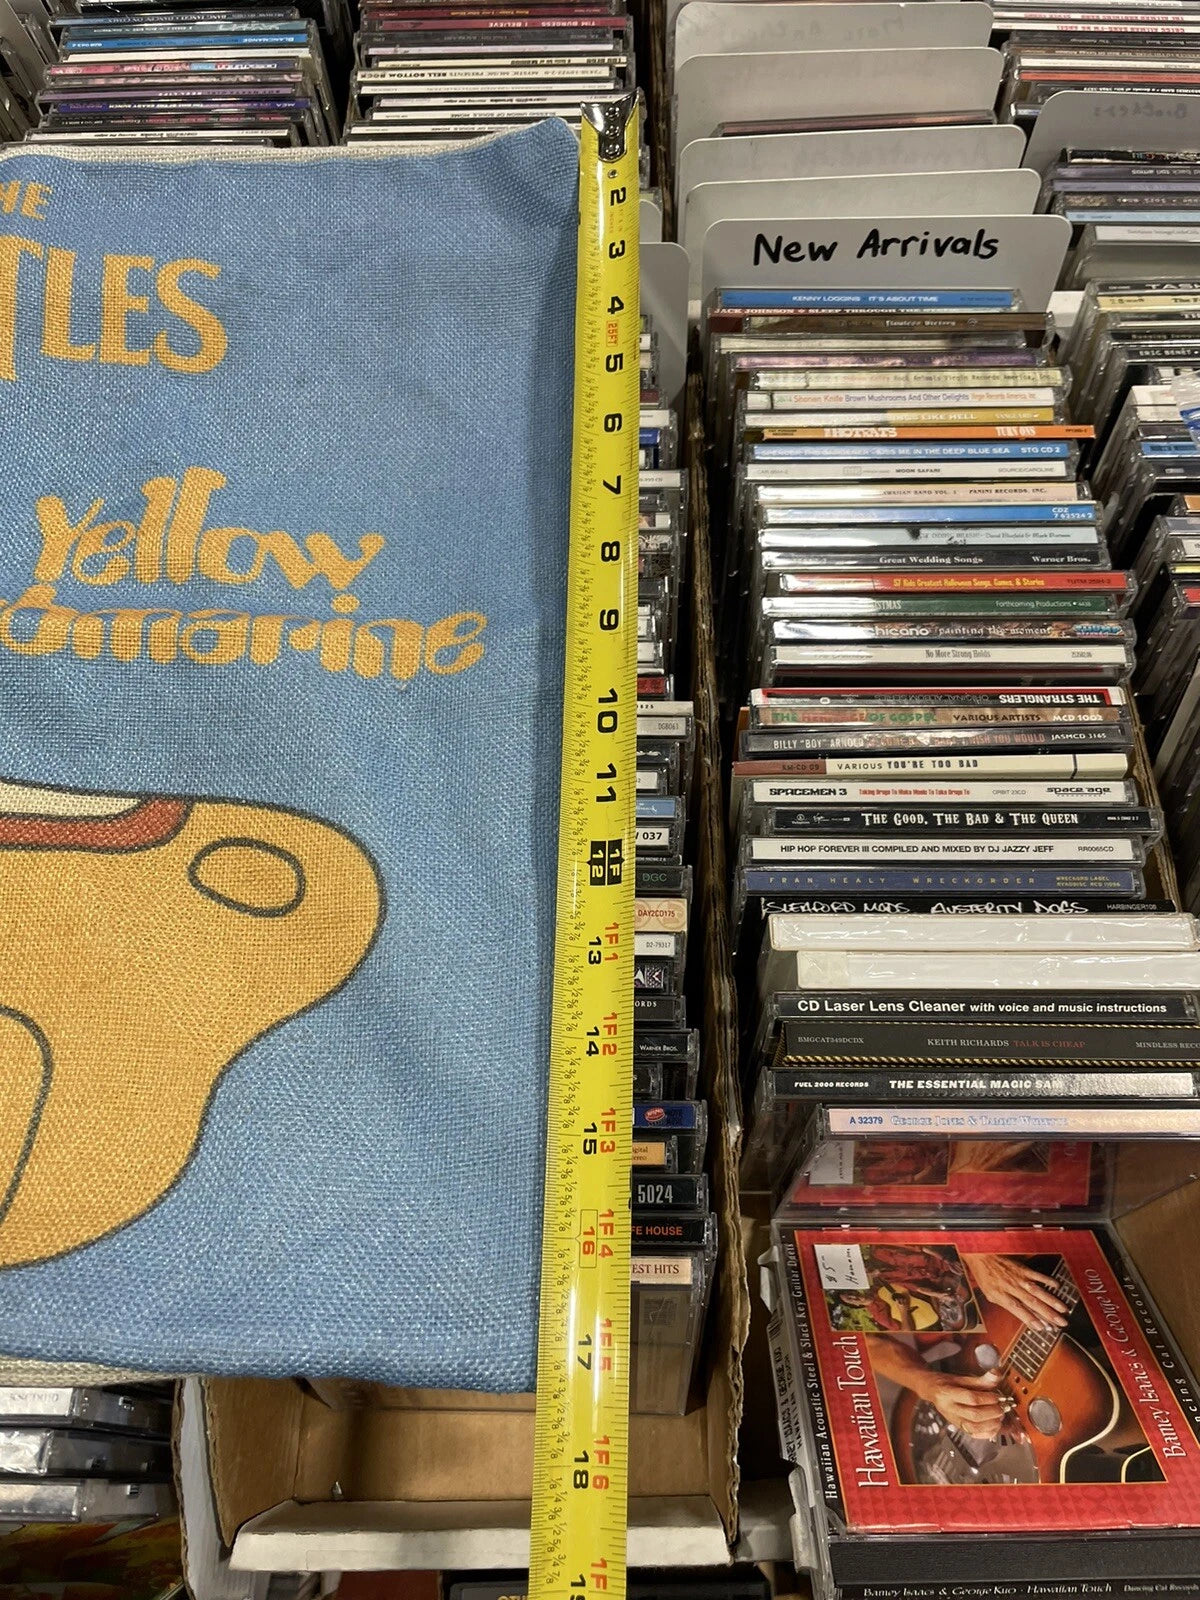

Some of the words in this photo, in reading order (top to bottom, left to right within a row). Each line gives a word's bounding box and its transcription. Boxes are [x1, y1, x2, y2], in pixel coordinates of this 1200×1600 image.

[610, 188, 626, 206] 2
[608, 240, 625, 259] 3
[753, 233, 837, 266] New
[857, 229, 1000, 261] Arrivals
[607, 295, 624, 314] 4
[605, 353, 623, 372] 5
[942, 393, 969, 401] Delights
[604, 413, 622, 432] 6
[603, 475, 621, 495] 7
[34, 466, 385, 590] Yellow
[600, 540, 620, 562] 8
[909, 556, 951, 564] Wedding
[600, 609, 619, 630] 9
[936, 650, 950, 658] More
[952, 650, 972, 659] Strong
[999, 695, 1075, 704] STRANGLERS
[1078, 695, 1100, 704] THE
[597, 688, 618, 733] 10
[772, 713, 797, 722] THE
[868, 713, 885, 722] OF
[773, 740, 797, 749] BILLY
[800, 739, 827, 748] "BOY"
[994, 734, 1011, 742] YOU
[1015, 733, 1045, 742] WOULD
[887, 760, 924, 768] YOU'RE
[932, 760, 952, 768] TOO
[596, 762, 617, 802] 11
[769, 788, 837, 796] SPACEMEN
[839, 788, 847, 796] 3
[861, 813, 888, 826] THE
[894, 813, 928, 826] GOOD,
[933, 813, 960, 825] THE
[966, 813, 989, 825] BAD
[995, 813, 1004, 824] &
[1009, 813, 1036, 825] THE
[1042, 813, 1078, 825] QUEEN
[642, 831, 663, 841] 037
[780, 845, 796, 853] HIP
[798, 845, 815, 853] HOP
[819, 845, 860, 853] FOREVER
[872, 845, 919, 853] COMPILED
[921, 845, 940, 853] AND
[591, 849, 604, 878] 12
[642, 872, 668, 882] DGC
[864, 903, 910, 913] MODS
[931, 902, 1023, 913] AUSTERITY
[1033, 901, 1089, 914] DOGS
[588, 936, 602, 965] 13
[797, 1000, 820, 1012] CD
[825, 1000, 865, 1012] Laser
[870, 1000, 905, 1012] Lens
[909, 1000, 965, 1012] Cleaner
[970, 1003, 995, 1012] with
[999, 1003, 1029, 1013] voice
[1032, 1003, 1055, 1012] and
[1058, 1004, 1093, 1013] music
[1096, 1003, 1167, 1013] instructions
[586, 1026, 600, 1057] 14
[639, 1044, 662, 1052] WARNER
[927, 1039, 957, 1047] KEITH
[960, 1039, 1009, 1048] RICHARDS
[1013, 1040, 1039, 1048] TALK
[1041, 1040, 1049, 1048] IS
[889, 1080, 914, 1089] THE
[917, 1080, 986, 1089] ESSENTIAL
[990, 1080, 1031, 1089] MAGIC
[1036, 1080, 1063, 1089] SAM
[850, 1117, 857, 1125] A
[858, 1116, 883, 1125] 32379
[583, 1122, 597, 1155] 15
[637, 1184, 673, 1205] 5024
[645, 1225, 683, 1236] HOUSE
[582, 1226, 597, 1256] 16
[653, 1263, 680, 1275] HITS
[792, 1272, 803, 1299] Guitar
[1084, 1269, 1107, 1295] Kuo
[796, 1300, 807, 1318] Key
[1098, 1295, 1129, 1343] George
[799, 1319, 812, 1350] Slack
[578, 1334, 593, 1371] 17
[833, 1335, 867, 1391] Touch
[806, 1361, 820, 1390] Steel
[1128, 1362, 1160, 1402] Isaacs
[812, 1393, 828, 1440] Acoustic
[855, 1392, 889, 1488] Hawaiian
[1150, 1406, 1188, 1458] Barney
[573, 1450, 589, 1489] 18
[821, 1443, 839, 1501] Hawaiian
[863, 1588, 901, 1598] Barney
[903, 1587, 934, 1597] Isaacs
[952, 1586, 993, 1598] George
[993, 1586, 1017, 1596] Kuo
[1026, 1584, 1078, 1595] Hawaiian
[1080, 1583, 1113, 1593] Touch
